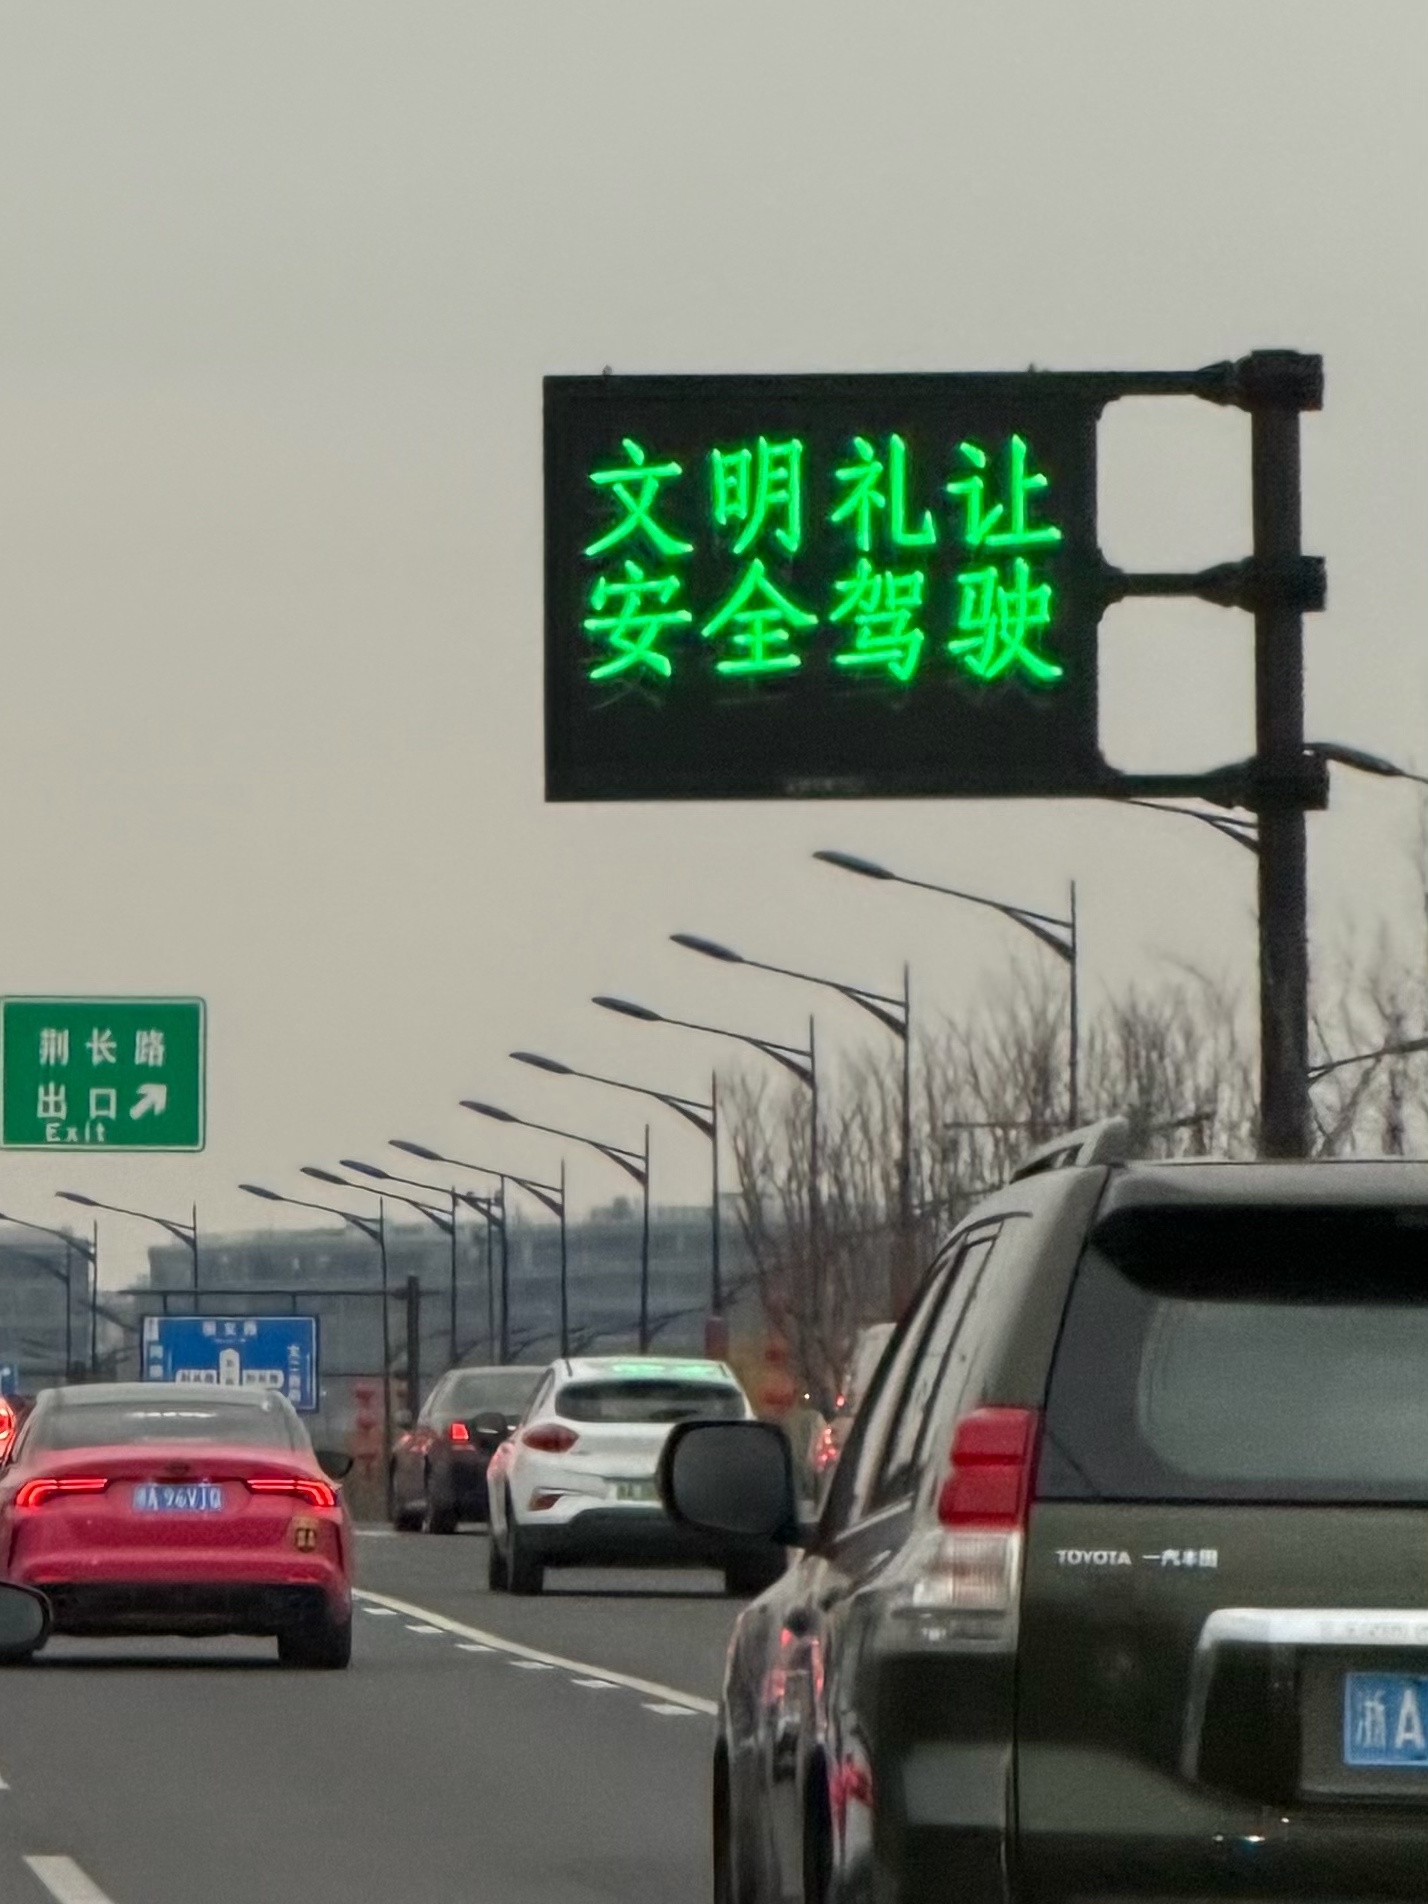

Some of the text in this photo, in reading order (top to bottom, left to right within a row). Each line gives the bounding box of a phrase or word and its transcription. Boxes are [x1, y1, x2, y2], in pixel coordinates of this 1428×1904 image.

[584, 433, 1063, 557] 文明礼让
[582, 558, 1064, 682] 安全驾驶
[37, 1081, 117, 1121] 出口
[46, 1121, 105, 1142] Exit
[1056, 1549, 1132, 1566] TOYOTA
